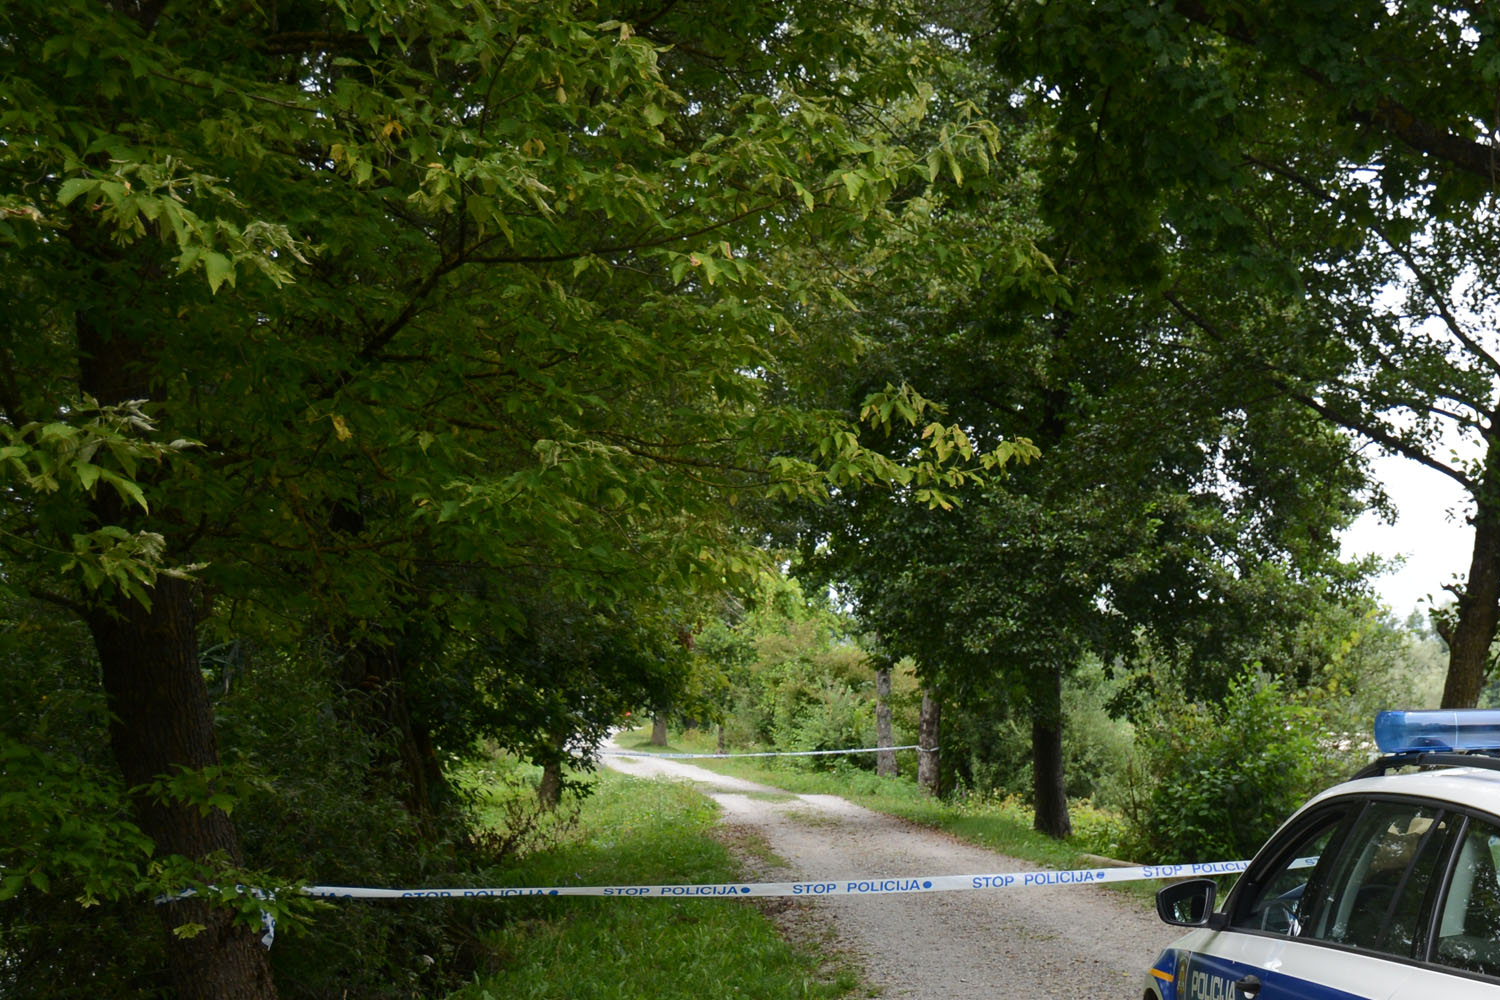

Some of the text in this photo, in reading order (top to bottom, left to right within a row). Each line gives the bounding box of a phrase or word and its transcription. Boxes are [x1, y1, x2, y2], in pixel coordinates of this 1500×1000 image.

[1143, 862, 1249, 878] STOP POLICIJ
[792, 880, 920, 895] STOP POLICIJA
[972, 871, 1094, 889] STOP POLICIJA
[603, 886, 738, 896] STOP POLICIJA
